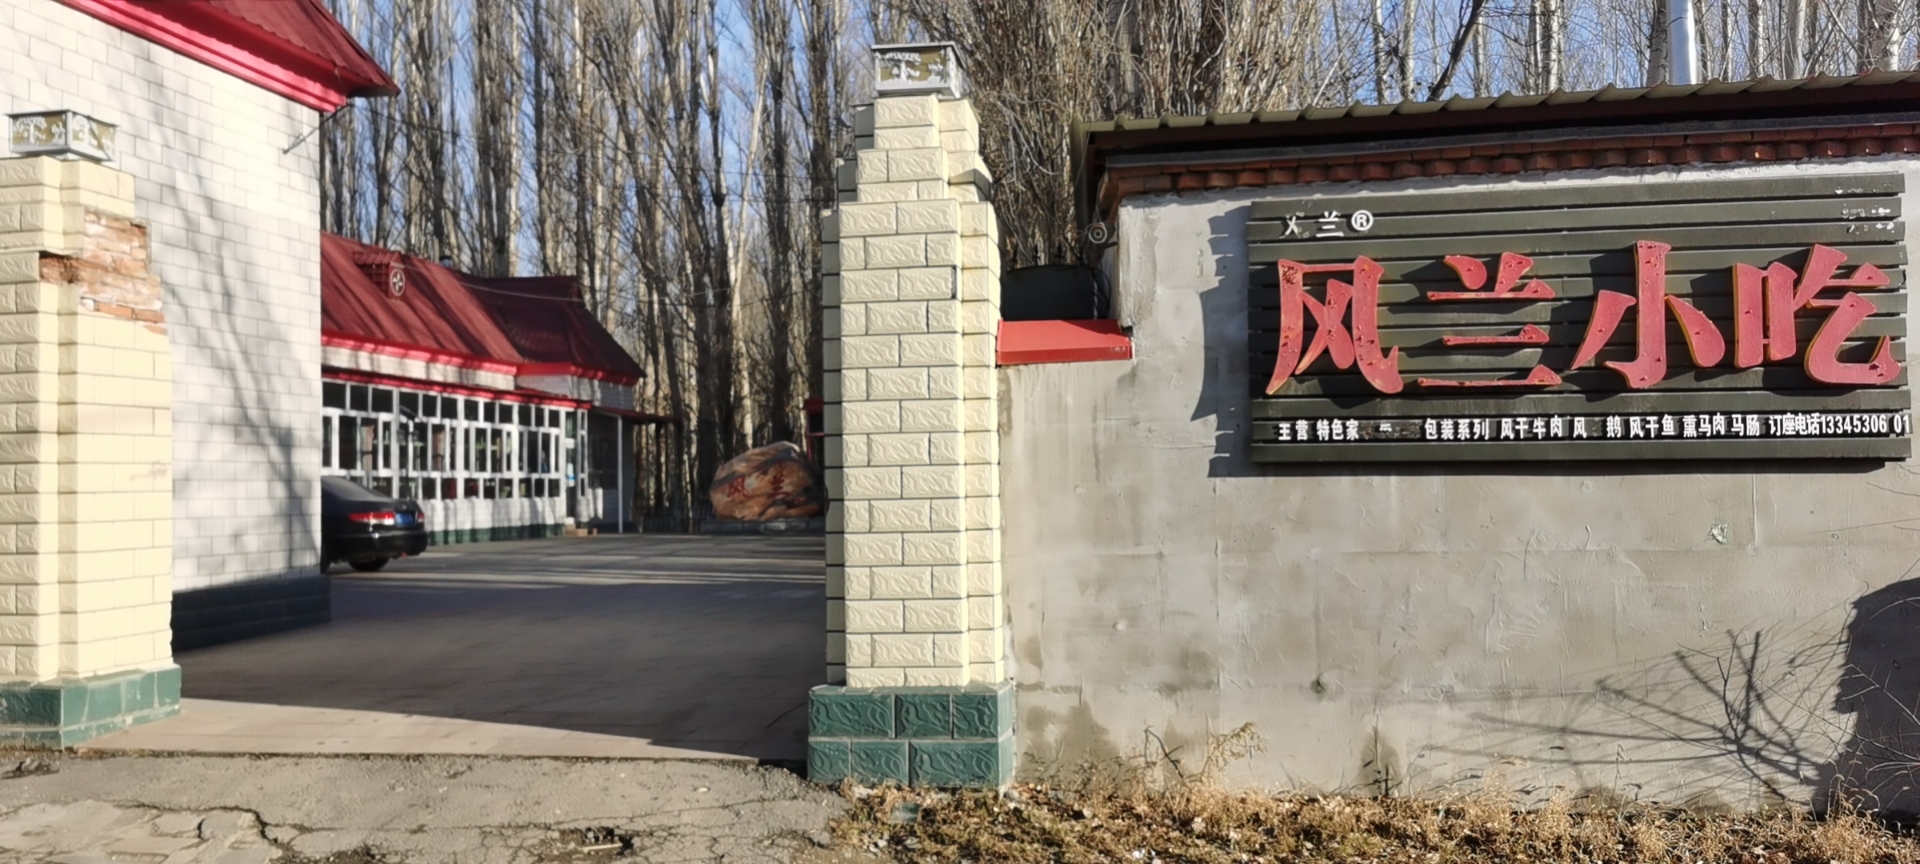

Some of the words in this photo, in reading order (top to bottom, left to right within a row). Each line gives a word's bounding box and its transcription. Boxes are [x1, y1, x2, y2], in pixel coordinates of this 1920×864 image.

[1265, 240, 1902, 395] 风兰小吃
[1500, 414, 1562, 439] 风干牛肉
[1573, 415, 1622, 438] 风鹅
[1629, 413, 1675, 438] 风干鱼
